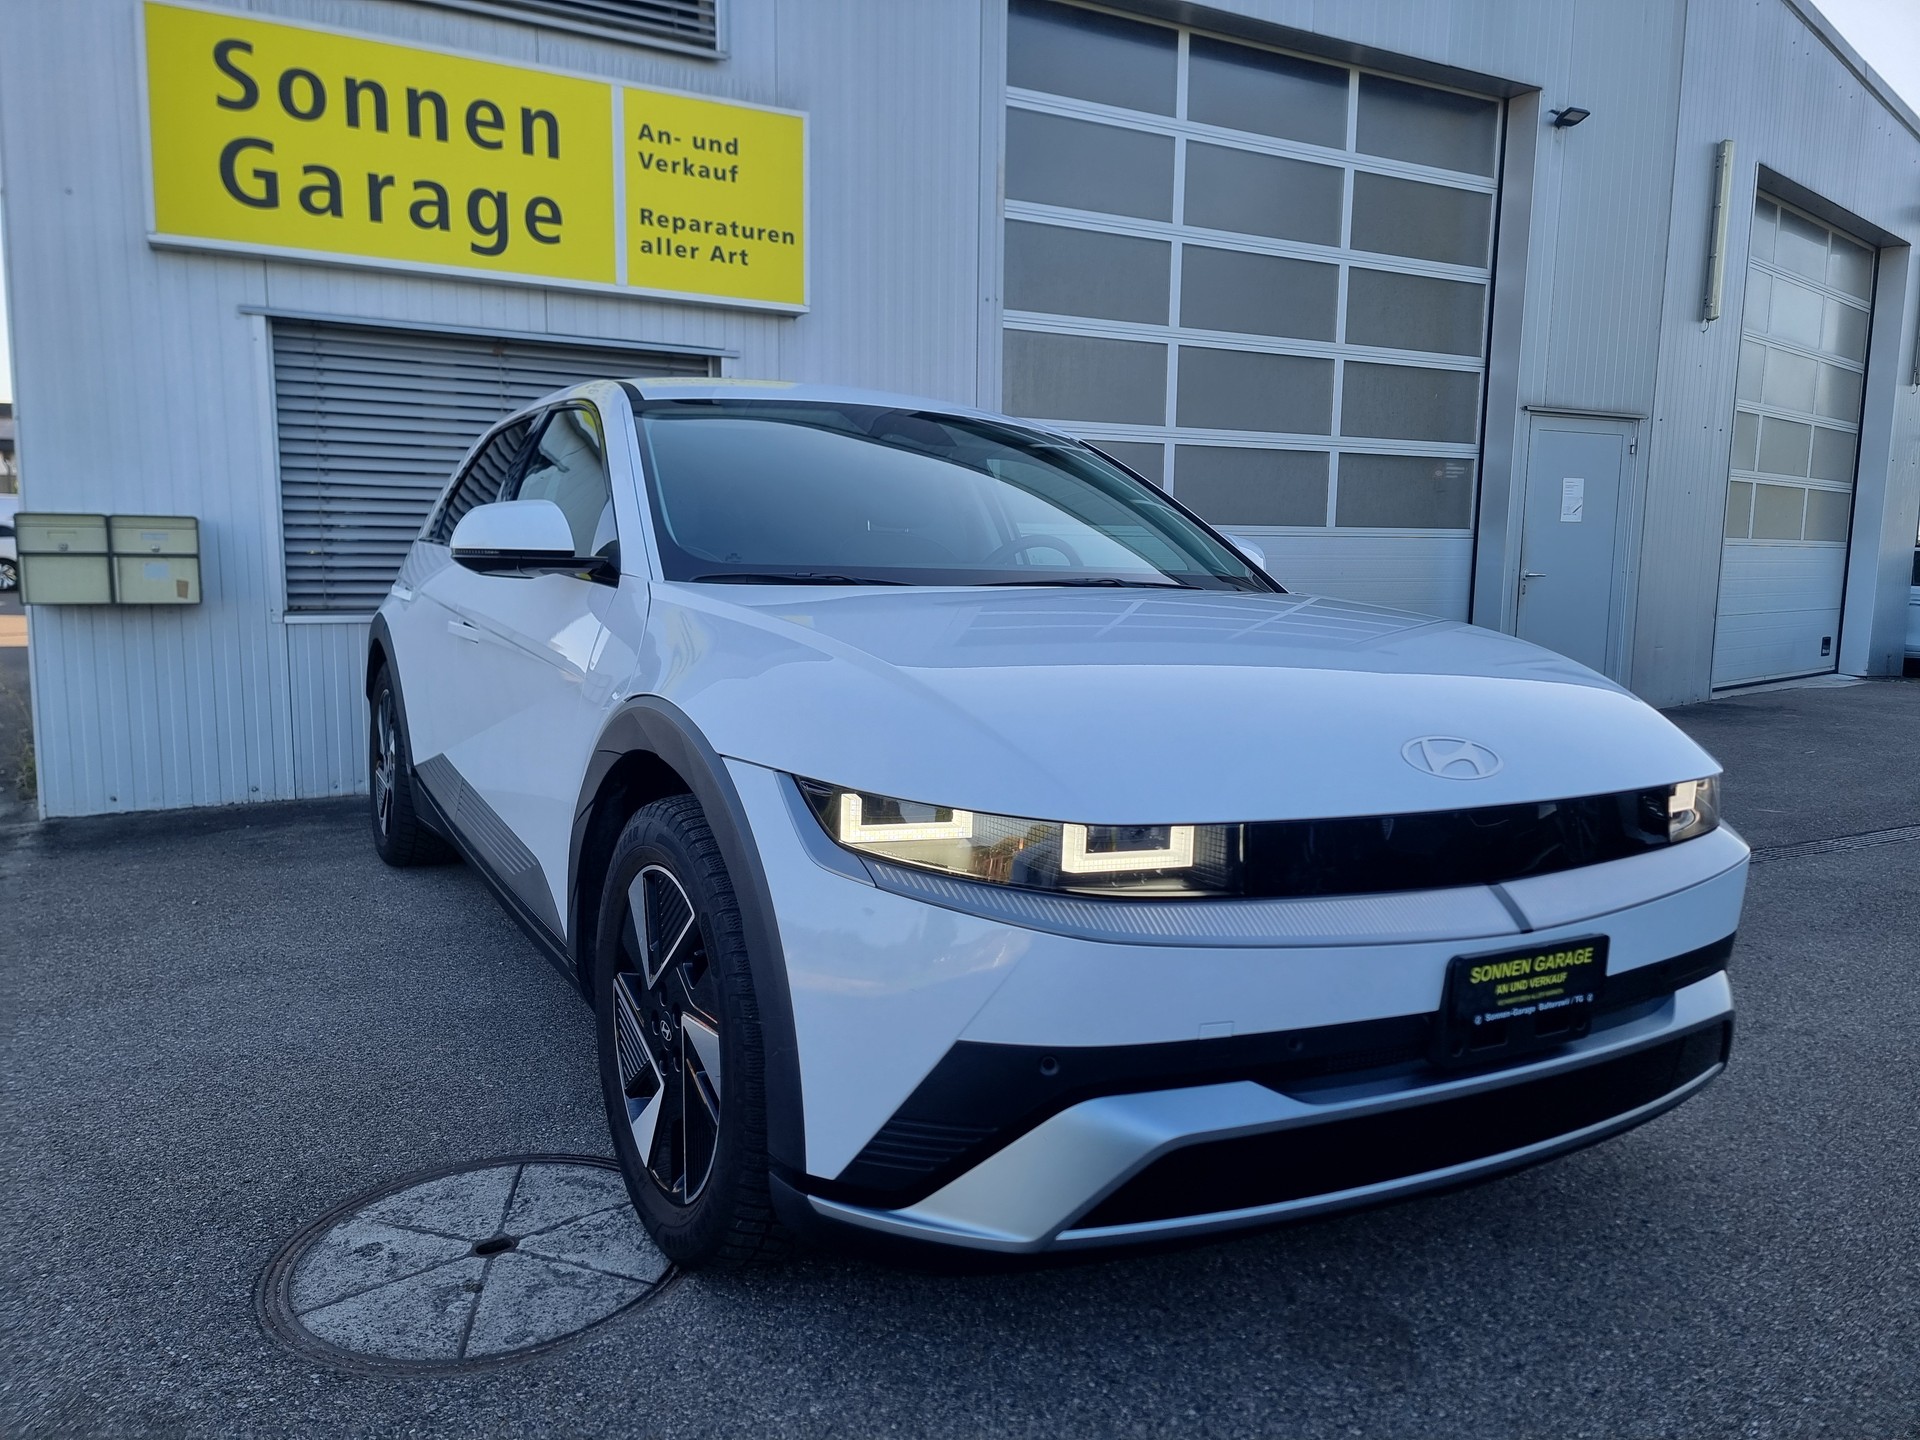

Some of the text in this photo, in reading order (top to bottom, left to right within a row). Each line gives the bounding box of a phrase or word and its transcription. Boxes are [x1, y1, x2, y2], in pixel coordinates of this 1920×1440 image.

[212, 38, 560, 160] Sonnen
[638, 123, 739, 157] An- und
[638, 151, 740, 184] Verkauf
[218, 137, 563, 257] Garage
[639, 208, 796, 246] Reparaturen
[639, 236, 750, 267] aller Art
[1470, 947, 1593, 983] SONNEN GARAGE
[1495, 972, 1568, 995] AN UND VERKAUF
